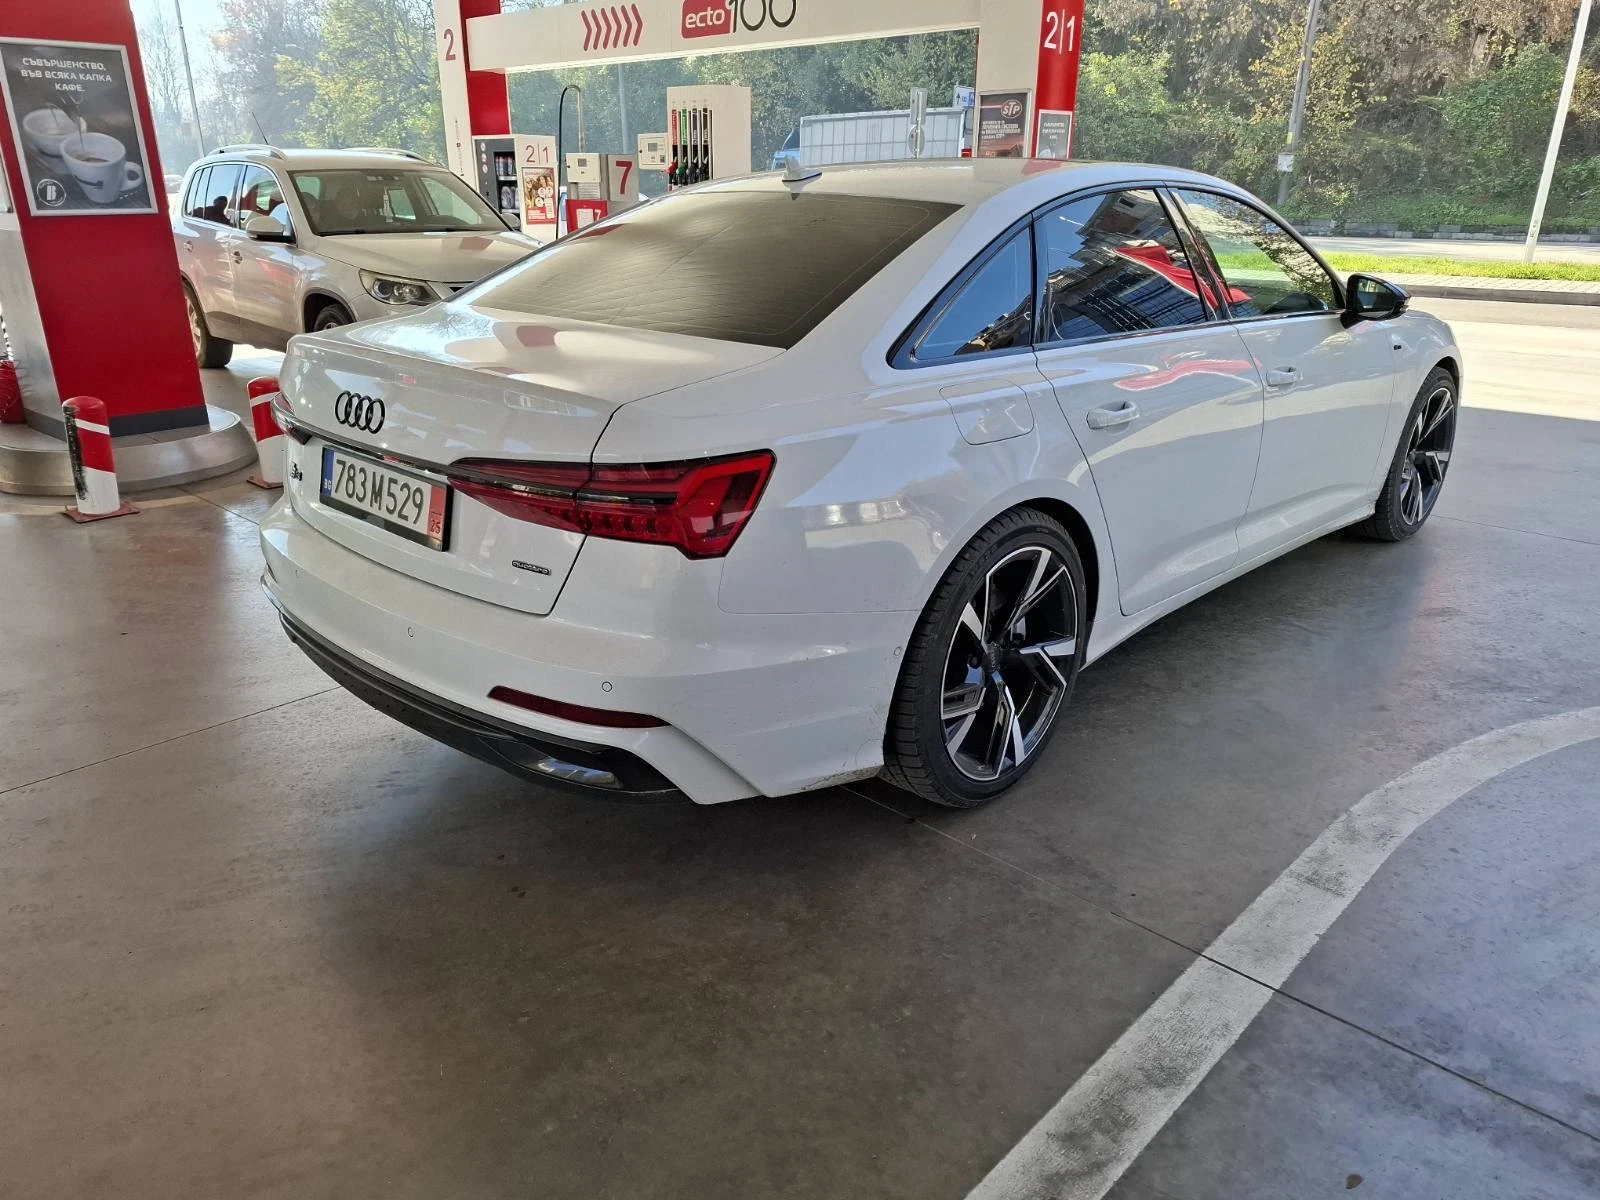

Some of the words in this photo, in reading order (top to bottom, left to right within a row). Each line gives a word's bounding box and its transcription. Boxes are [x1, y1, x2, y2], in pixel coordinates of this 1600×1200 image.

[685, 7, 725, 28] ecto
[443, 28, 456, 61] 2
[21, 69, 42, 78] ВЪВ
[45, 71, 77, 80] ВСЯКА
[79, 73, 112, 82] КАПКА
[1003, 101, 1020, 116] STP
[616, 160, 633, 195] 7
[594, 209, 602, 221] 7
